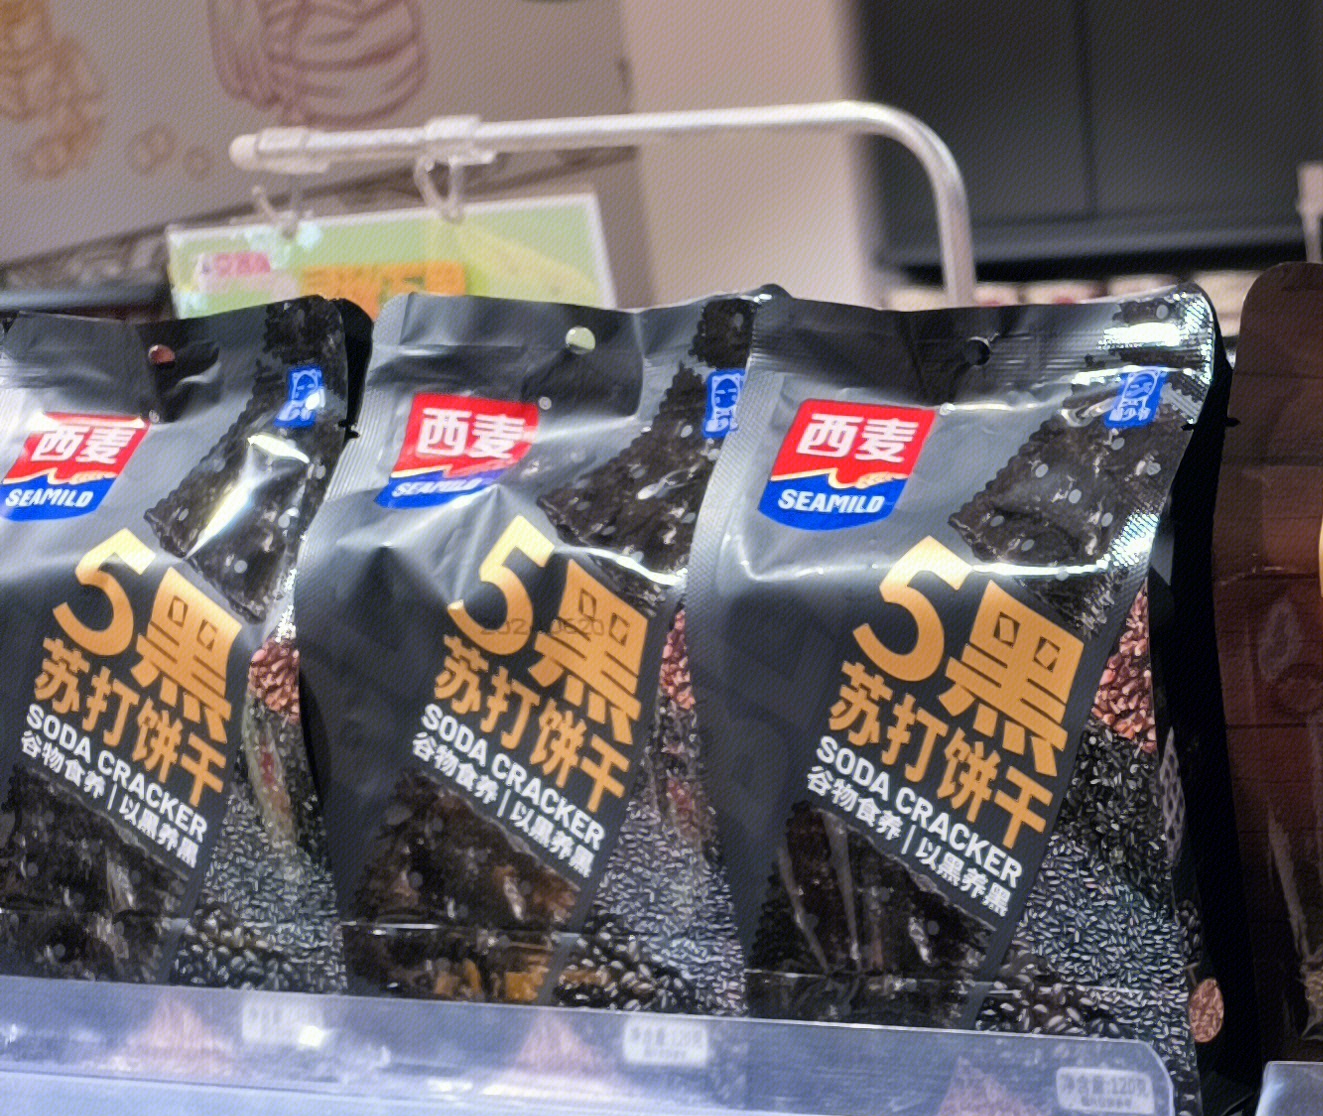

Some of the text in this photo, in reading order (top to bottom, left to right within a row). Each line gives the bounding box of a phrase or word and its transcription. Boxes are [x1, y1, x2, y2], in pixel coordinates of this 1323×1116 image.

[8, 486, 94, 509] SEAMILD
[31, 421, 135, 467] 西麦
[415, 406, 526, 460] 西麦
[778, 489, 884, 514] SEAMILD
[796, 412, 920, 464] 西麦
[25, 703, 208, 842] SODA CRACKER
[34, 637, 226, 806] 苏打饼干
[421, 703, 605, 850] SODA CRACKER
[434, 634, 630, 813] 苏打饼干
[829, 661, 1053, 849] 苏打饼干
[816, 736, 1023, 889] SODA CRACKER
